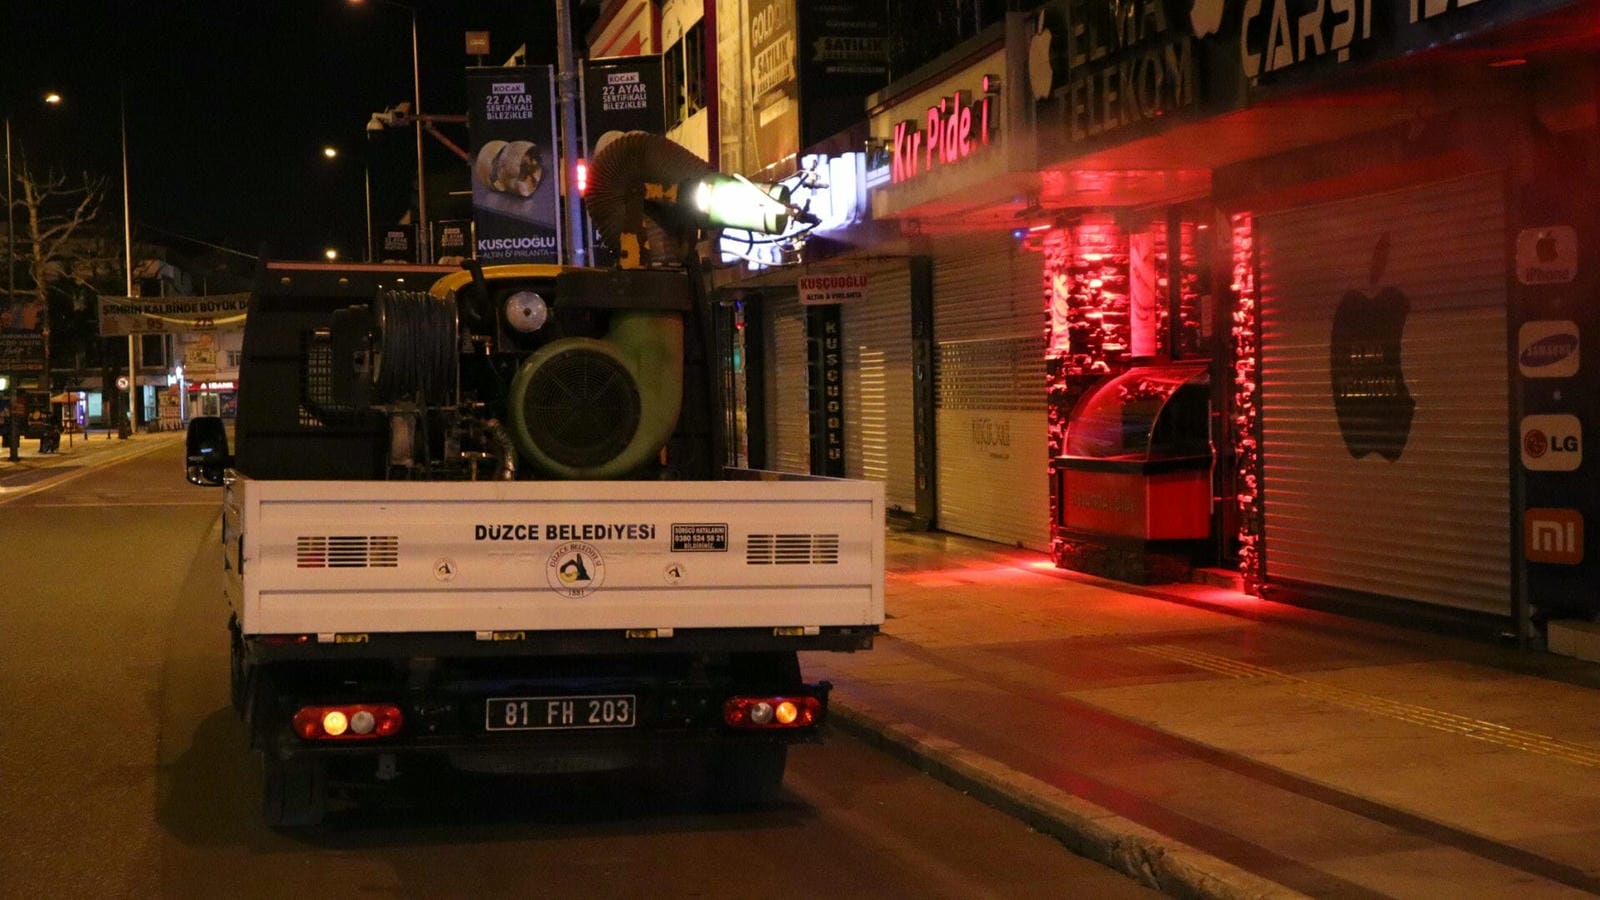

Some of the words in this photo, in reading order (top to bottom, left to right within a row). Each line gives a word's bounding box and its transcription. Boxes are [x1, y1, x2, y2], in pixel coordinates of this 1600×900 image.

[752, 4, 774, 48] GOLD
[758, 37, 789, 80] SATILIK
[602, 86, 615, 95] 22
[618, 84, 646, 94] AYAR
[1053, 35, 1193, 142] TELEKOM
[486, 95, 500, 105] 22
[503, 94, 532, 104] AYAR
[893, 120, 921, 184] Kır
[926, 75, 989, 169] Pidei
[200, 300, 237, 312] BÜYÜK
[1551, 436, 1578, 452] LG
[475, 524, 539, 540] DÜZCE
[545, 523, 656, 540] BELEDİYESİ
[716, 534, 724, 542] 21
[505, 701, 528, 725] 81
[548, 701, 574, 724] FH
[589, 700, 629, 723] 203
